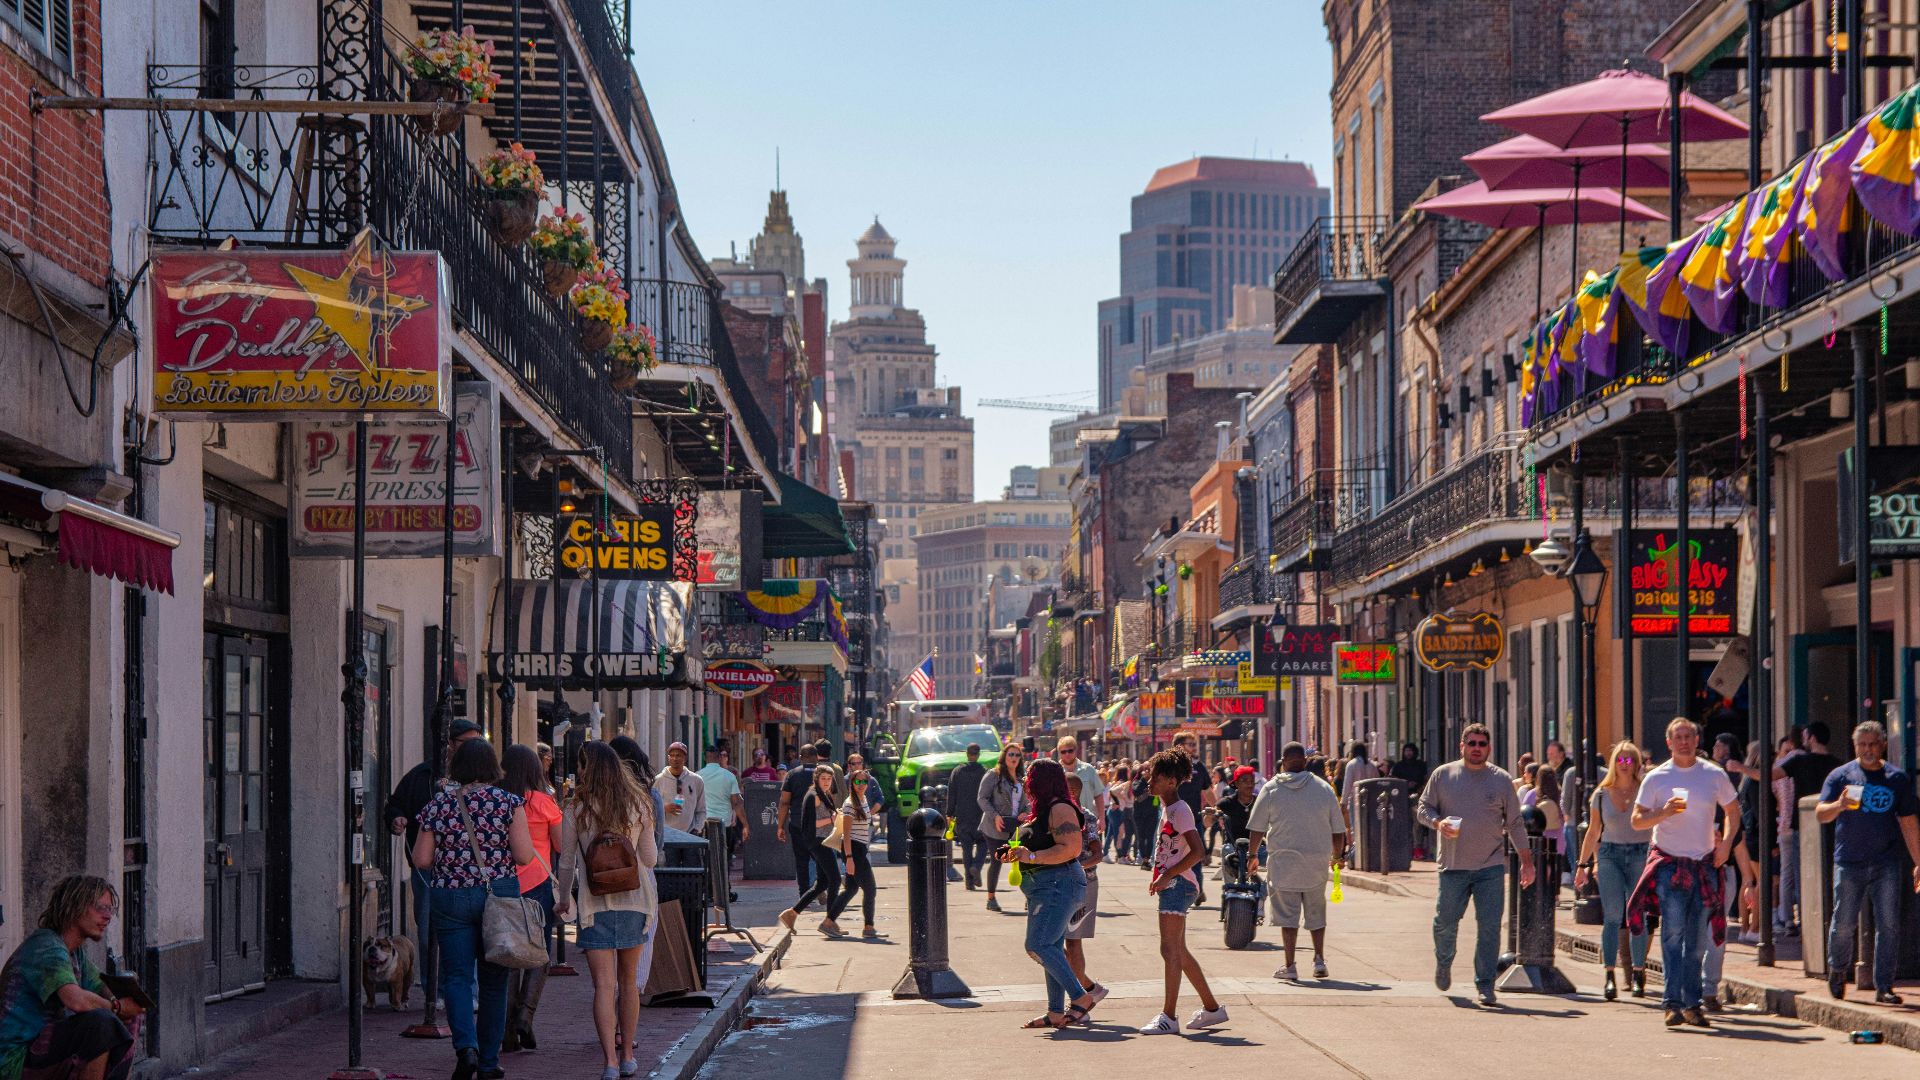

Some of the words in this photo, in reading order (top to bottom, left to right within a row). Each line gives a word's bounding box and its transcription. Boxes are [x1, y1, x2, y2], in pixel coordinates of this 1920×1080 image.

[162, 317, 351, 381] Daddy's
[166, 374, 320, 404] Bottomless
[326, 374, 436, 408] Topless
[306, 430, 480, 476] PIZZA
[335, 482, 447, 501] EPRESS
[365, 508, 384, 529] BY
[392, 508, 424, 529] THE
[428, 507, 475, 529] SLCE
[561, 546, 667, 570] OWENS
[1631, 559, 1669, 589] BIG
[1424, 634, 1500, 652] BANDSTAND
[496, 654, 573, 677] CHRIS
[583, 654, 674, 677] OWENS
[704, 670, 775, 684] DIXIELAND
[1246, 696, 1265, 715] CLUB
[1069, 905, 1087, 924] NIKE
